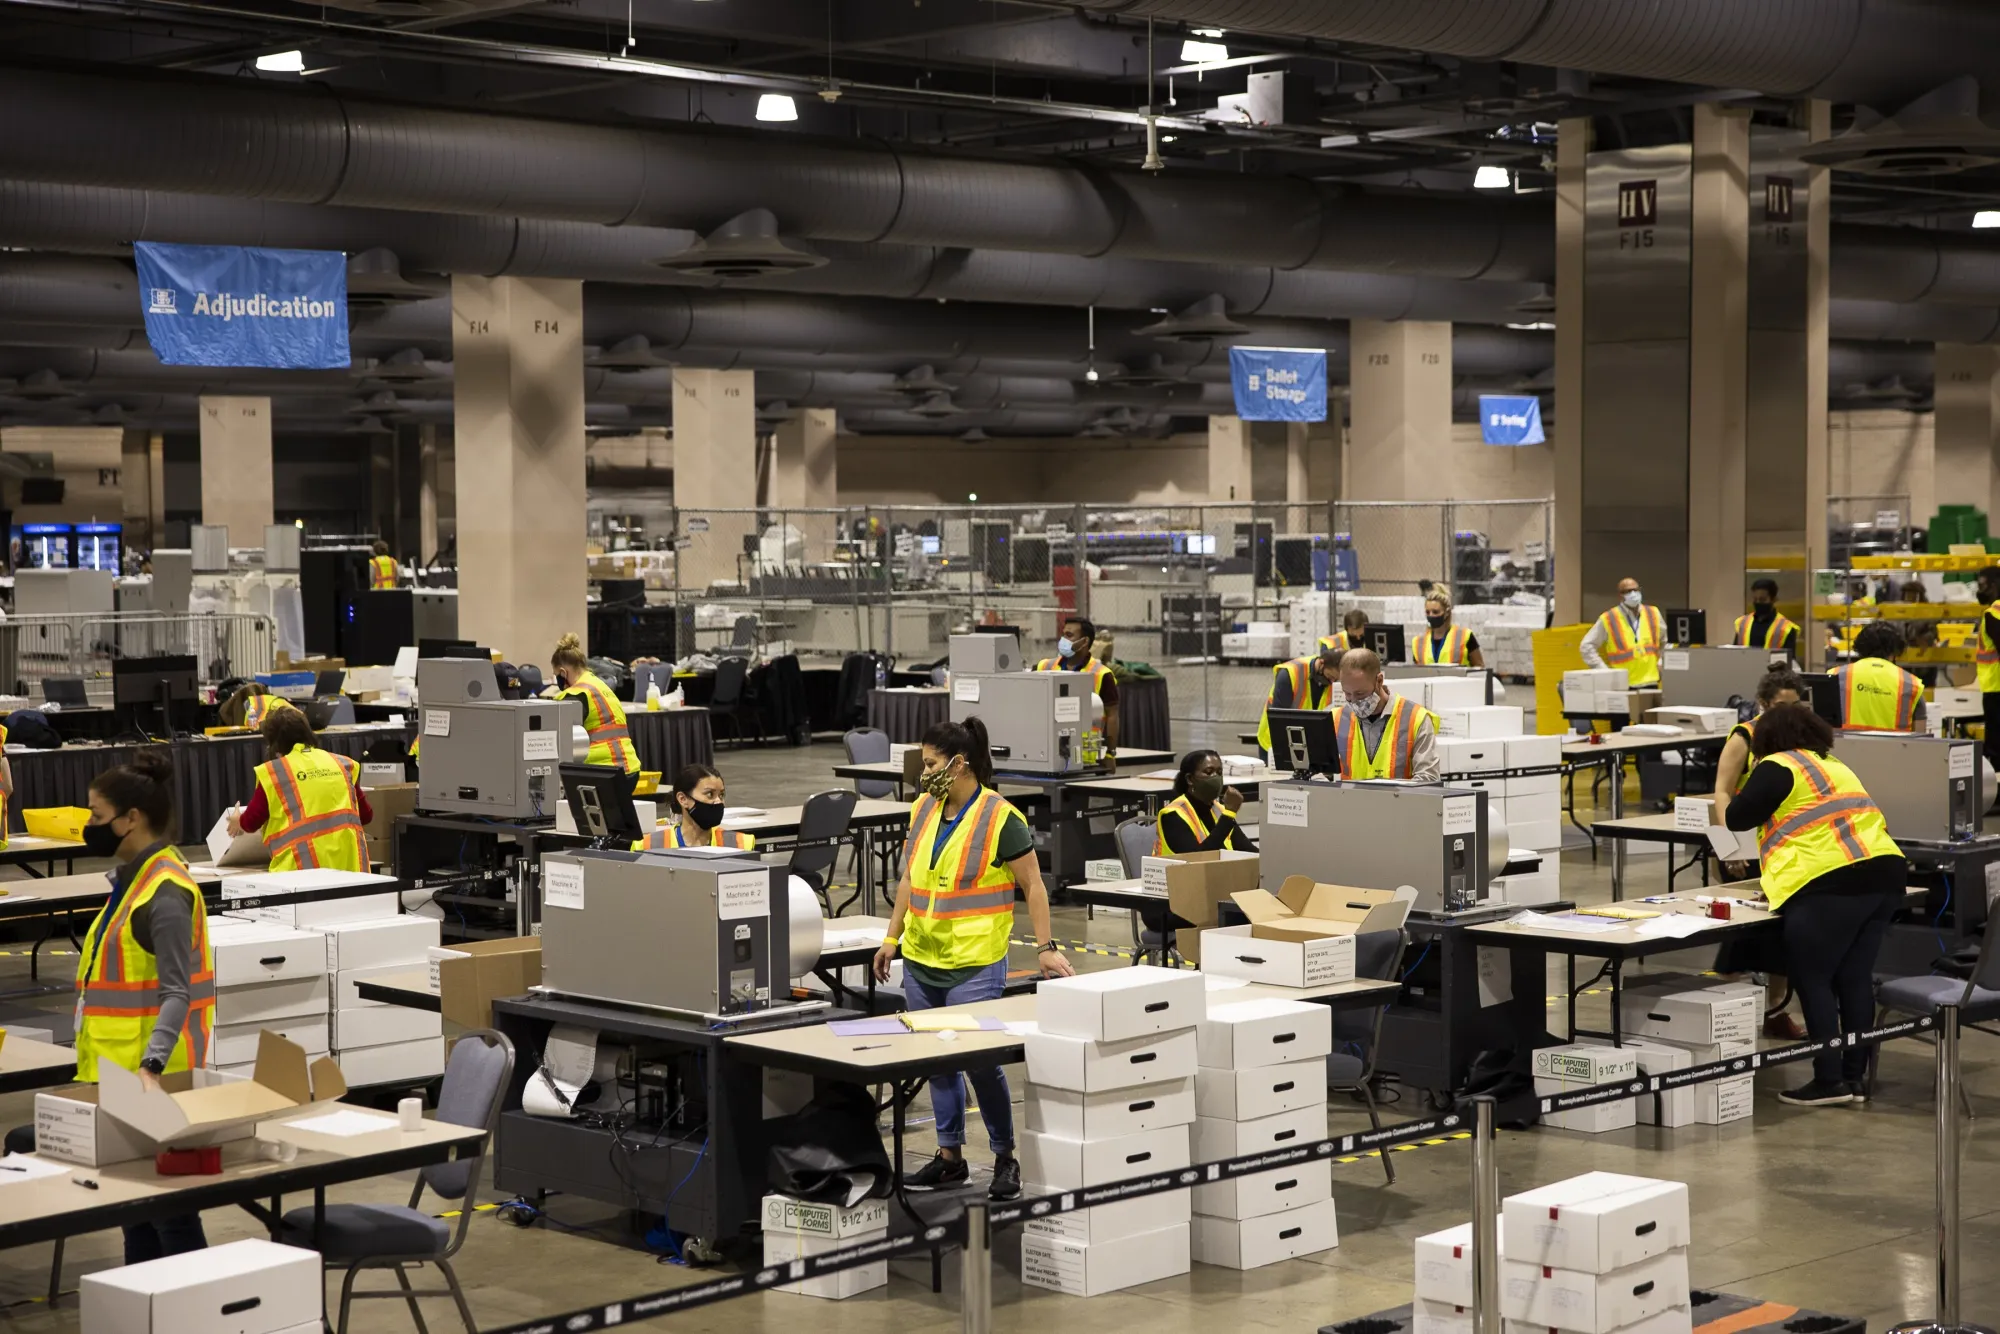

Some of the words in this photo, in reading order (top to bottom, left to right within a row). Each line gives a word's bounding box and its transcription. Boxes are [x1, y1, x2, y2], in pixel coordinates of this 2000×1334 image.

[1620, 229, 1653, 250] F15
[192, 292, 335, 322] Adjudication
[470, 320, 488, 334] F14
[534, 320, 558, 334] F14
[1266, 368, 1298, 384] Ballot
[1266, 384, 1306, 404] Storage
[552, 880, 569, 888] Machine
[1862, 1028, 1883, 1039] Pennsylvania
[1883, 1025, 1903, 1034] Convention
[1767, 1050, 1790, 1060] Pennsylvania
[1791, 1045, 1810, 1056] Convention
[1553, 1058, 1588, 1067] COMPUTER
[1566, 1066, 1588, 1075] FORMS
[1599, 1066, 1603, 1076] 9
[1666, 1074, 1691, 1084] Pennsylvania
[1692, 1069, 1713, 1078] Convention
[1558, 1095, 1585, 1106] Pennsylvania
[1586, 1091, 1608, 1100] Convention
[1362, 1130, 1392, 1143] Pennsylvania
[1392, 1124, 1419, 1137] Convention
[1419, 1121, 1435, 1130] Center
[1229, 1158, 1262, 1171] Pennsylvania
[1262, 1152, 1290, 1165] Convention
[1291, 1150, 1308, 1158] Center
[1084, 1188, 1120, 1200] Pennsylvania
[1121, 1181, 1152, 1194] Convention
[1152, 1178, 1170, 1187] Center
[787, 1208, 829, 1220] COMPUTER
[842, 1216, 847, 1227] 9
[866, 1213, 872, 1221] x
[803, 1218, 828, 1229] FORMS
[1026, 1248, 1041, 1257] ELECTION
[1064, 1246, 1080, 1255] ELECTION
